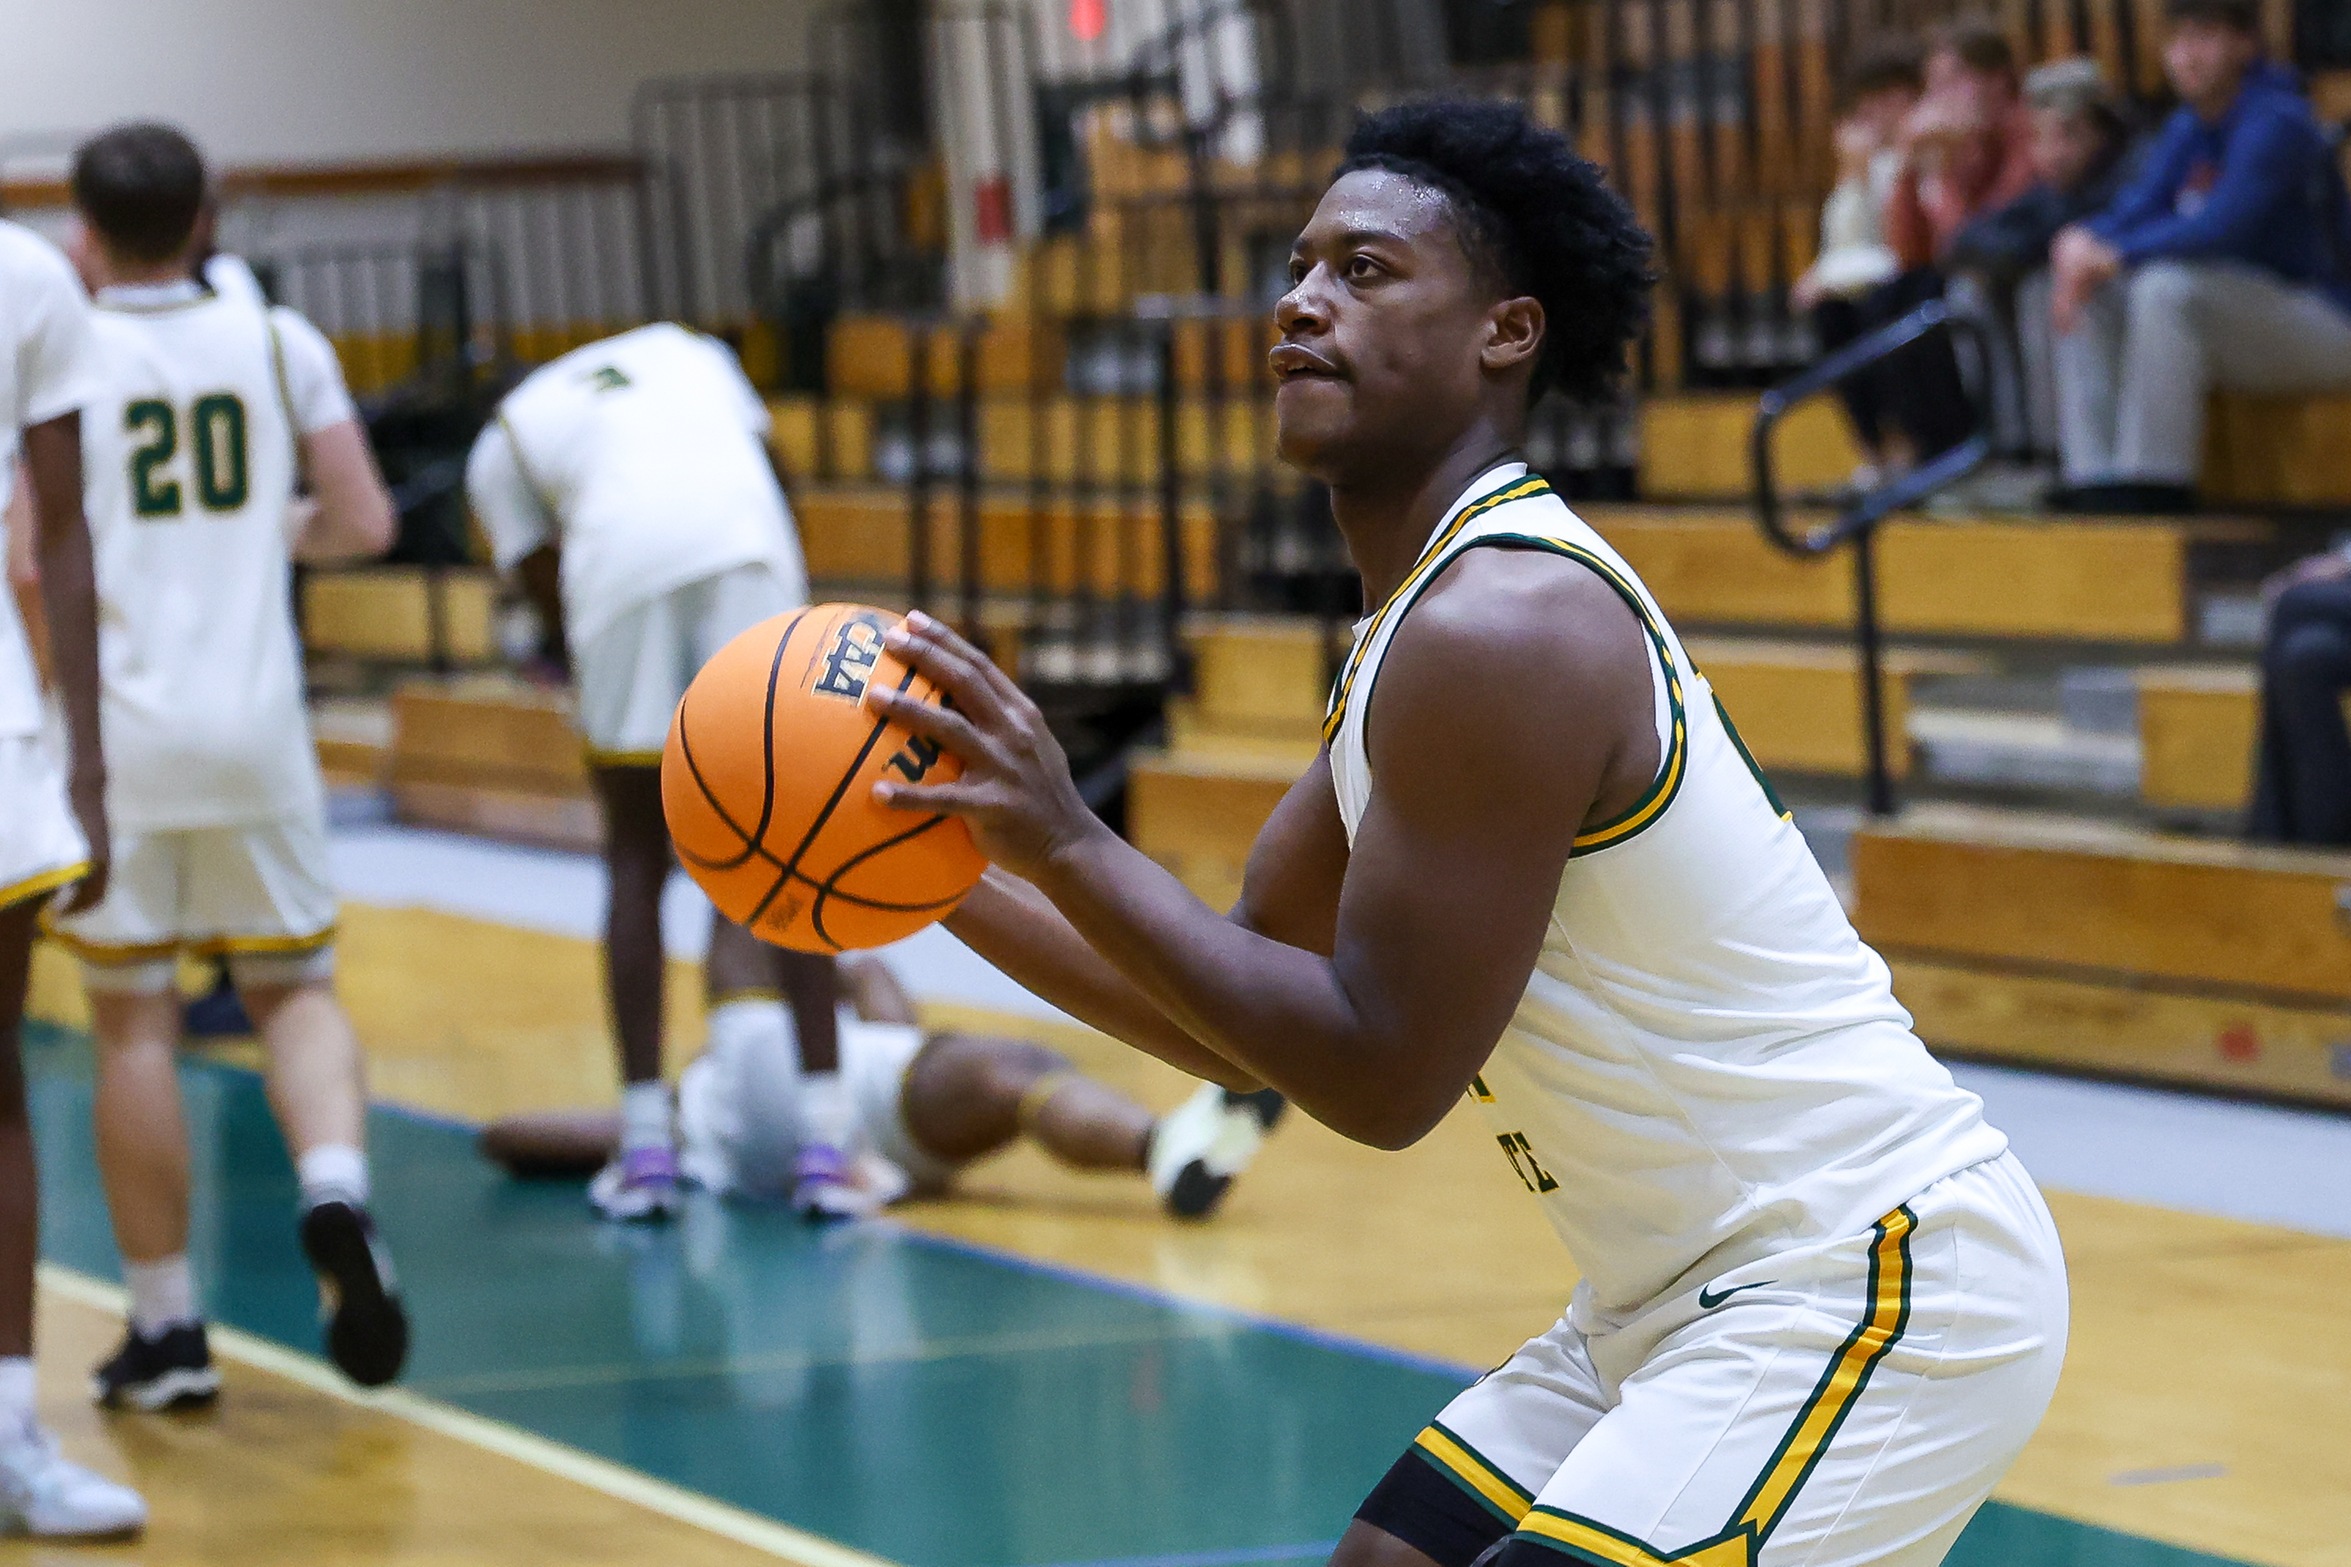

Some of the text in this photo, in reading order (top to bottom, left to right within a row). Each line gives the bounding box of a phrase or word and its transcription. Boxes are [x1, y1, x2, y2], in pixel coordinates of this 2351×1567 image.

[125, 393, 248, 516] 20
[811, 611, 887, 706] CAA
[1496, 1130, 1560, 1193] TE
